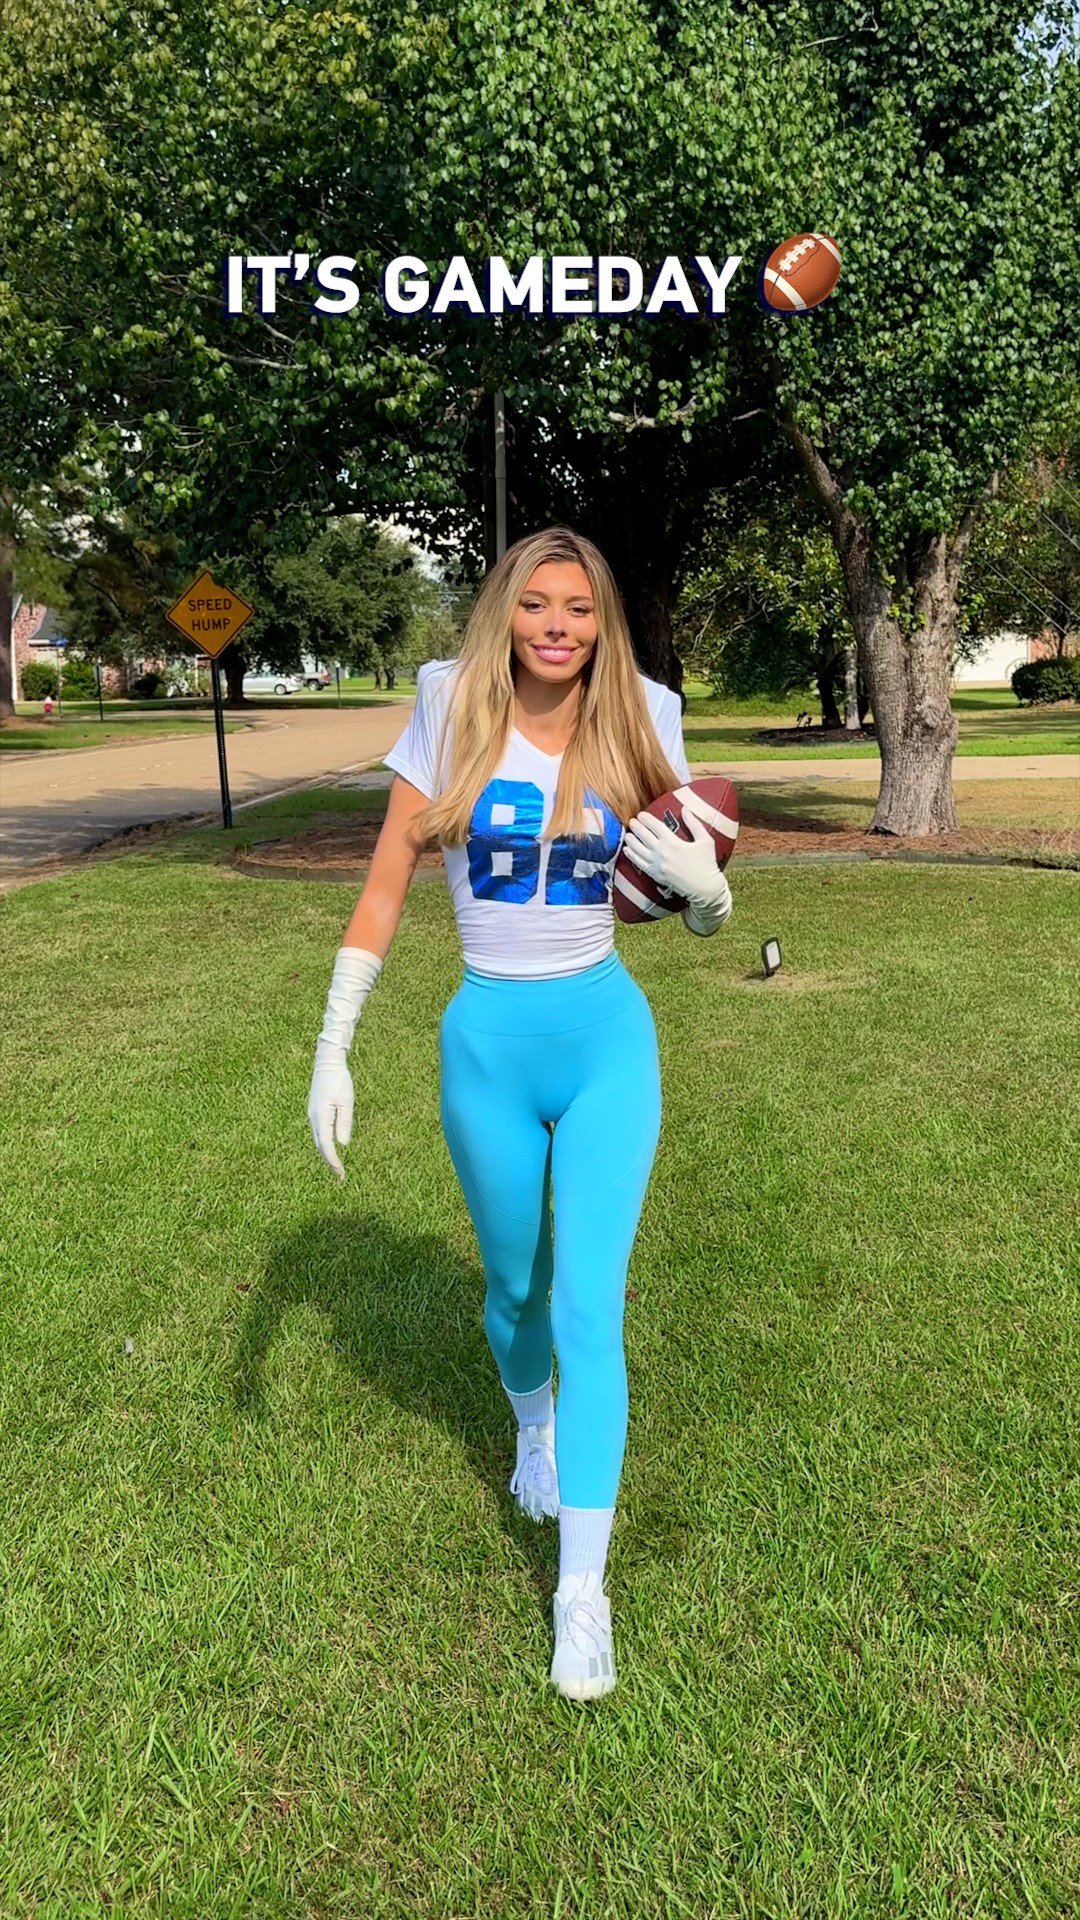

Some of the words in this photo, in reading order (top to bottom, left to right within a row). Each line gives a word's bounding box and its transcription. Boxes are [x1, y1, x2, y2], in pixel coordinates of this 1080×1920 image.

[188, 599, 232, 612] SPEED
[192, 618, 231, 632] HUMP
[466, 778, 623, 905] 82
